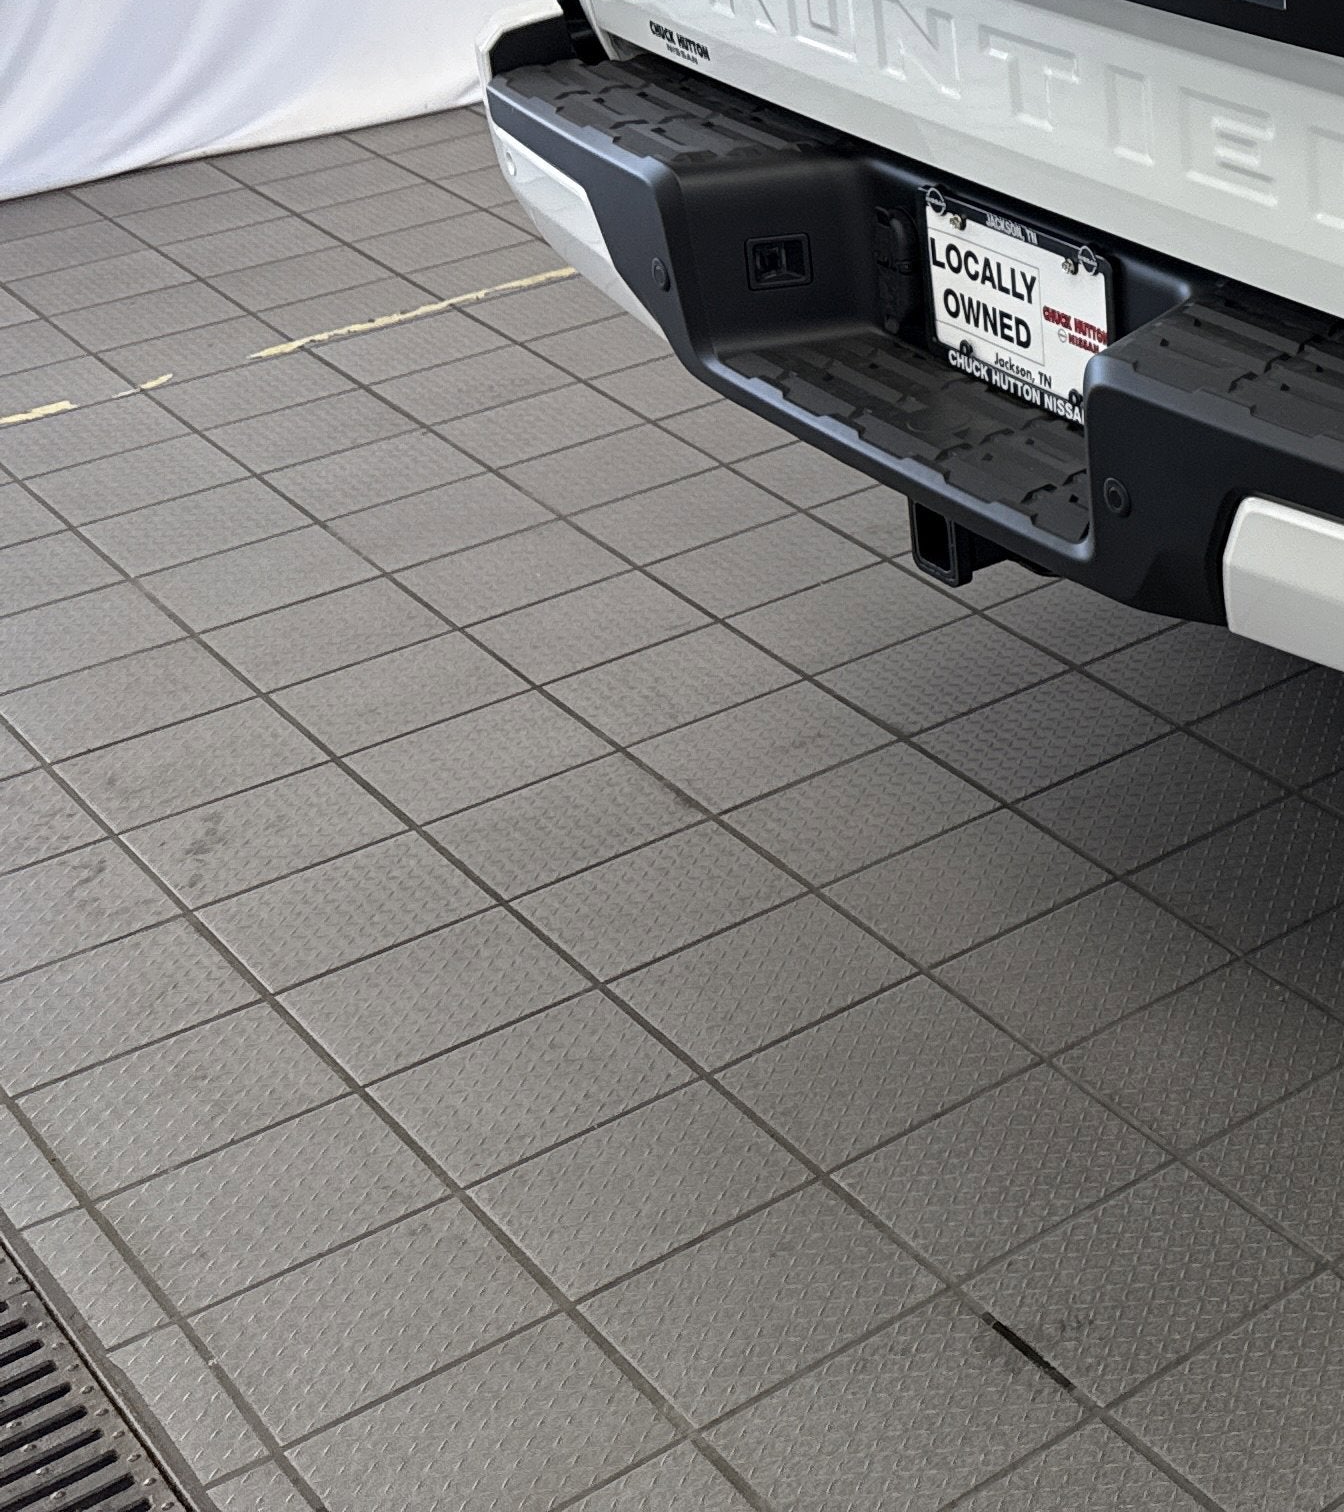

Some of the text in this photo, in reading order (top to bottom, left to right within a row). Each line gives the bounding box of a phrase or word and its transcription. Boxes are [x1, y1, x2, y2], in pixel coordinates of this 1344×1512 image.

[649, 20, 711, 61] CHUCK HUTTON
[929, 237, 1037, 304] LOCALLY
[943, 288, 1031, 349] OWNED
[1042, 305, 1073, 331] CHUCK
[948, 350, 989, 382] CHUCK
[991, 369, 1041, 406] HUTTON
[994, 352, 1052, 389] Jackson, TN
